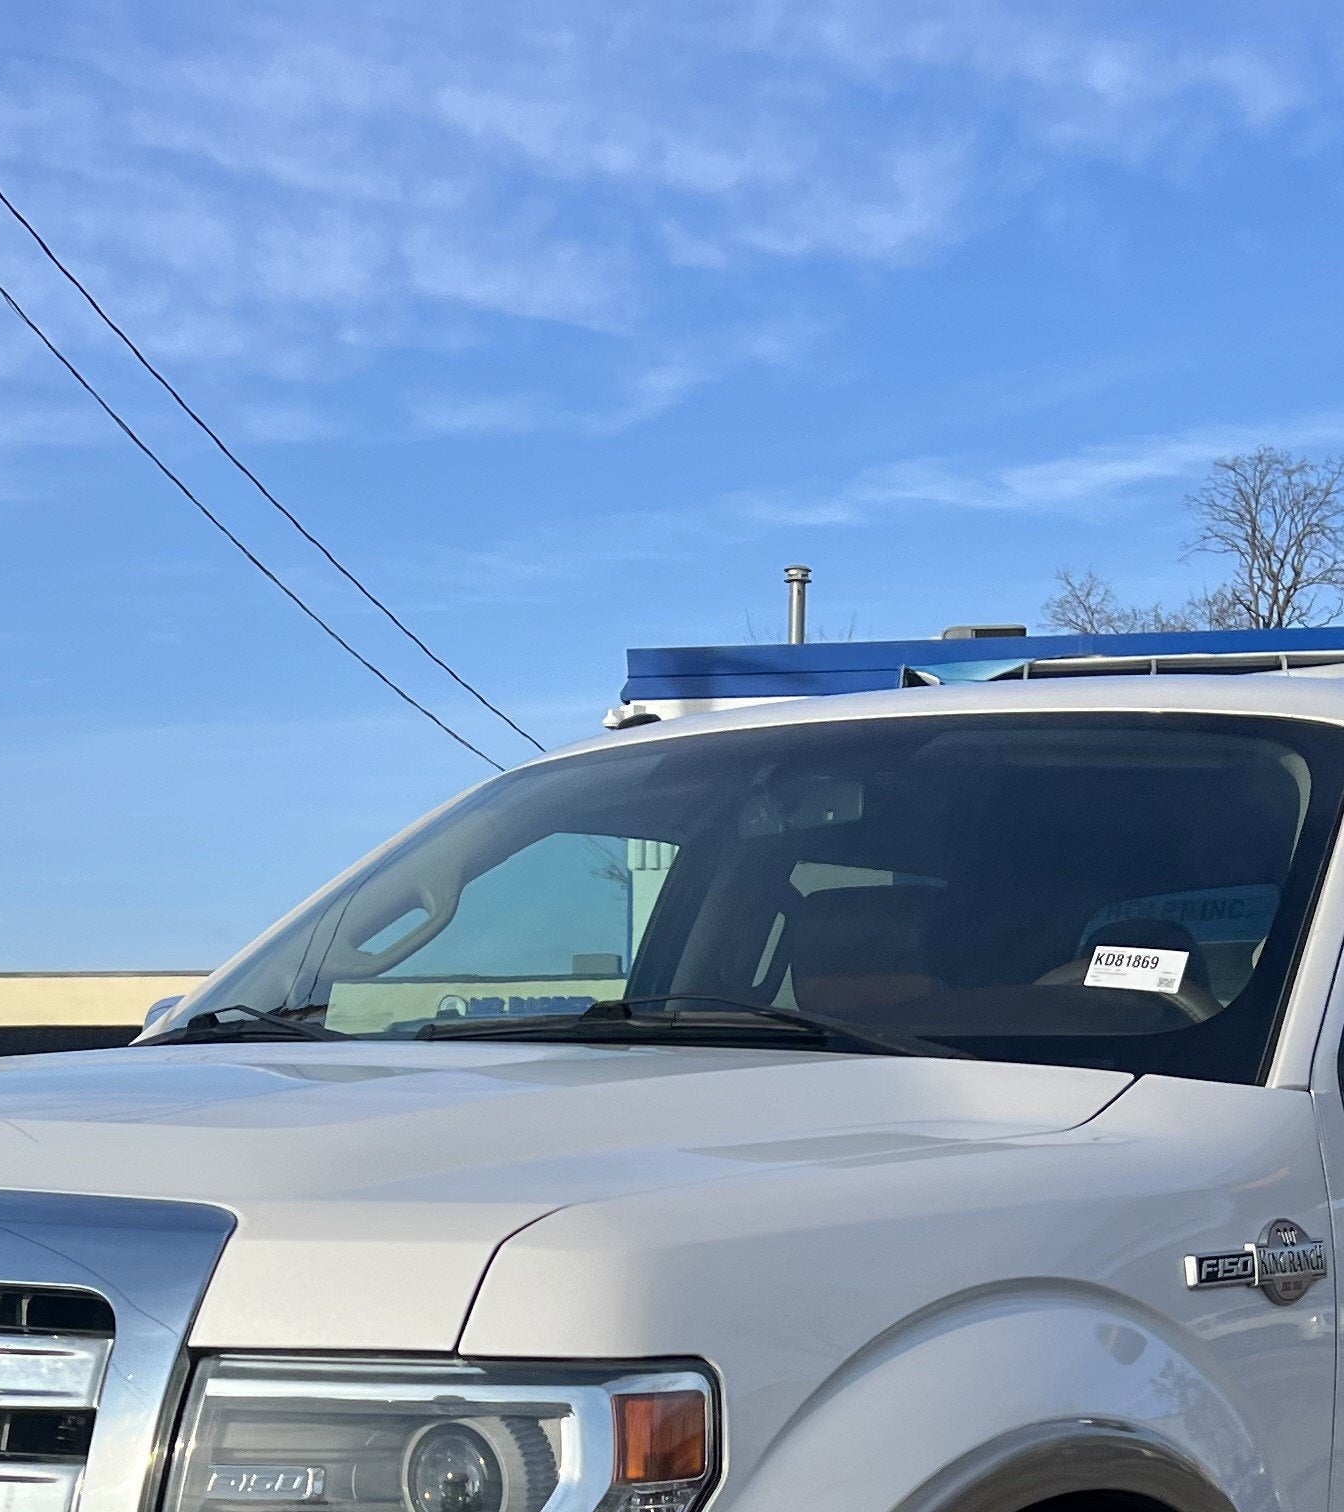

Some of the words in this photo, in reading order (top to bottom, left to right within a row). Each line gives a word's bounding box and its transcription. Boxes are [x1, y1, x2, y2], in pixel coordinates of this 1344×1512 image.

[1093, 952, 1160, 970] KD81869
[1201, 1255, 1253, 1280] F-150
[1258, 1247, 1285, 1275] KING
[1288, 1244, 1325, 1273] RANCH
